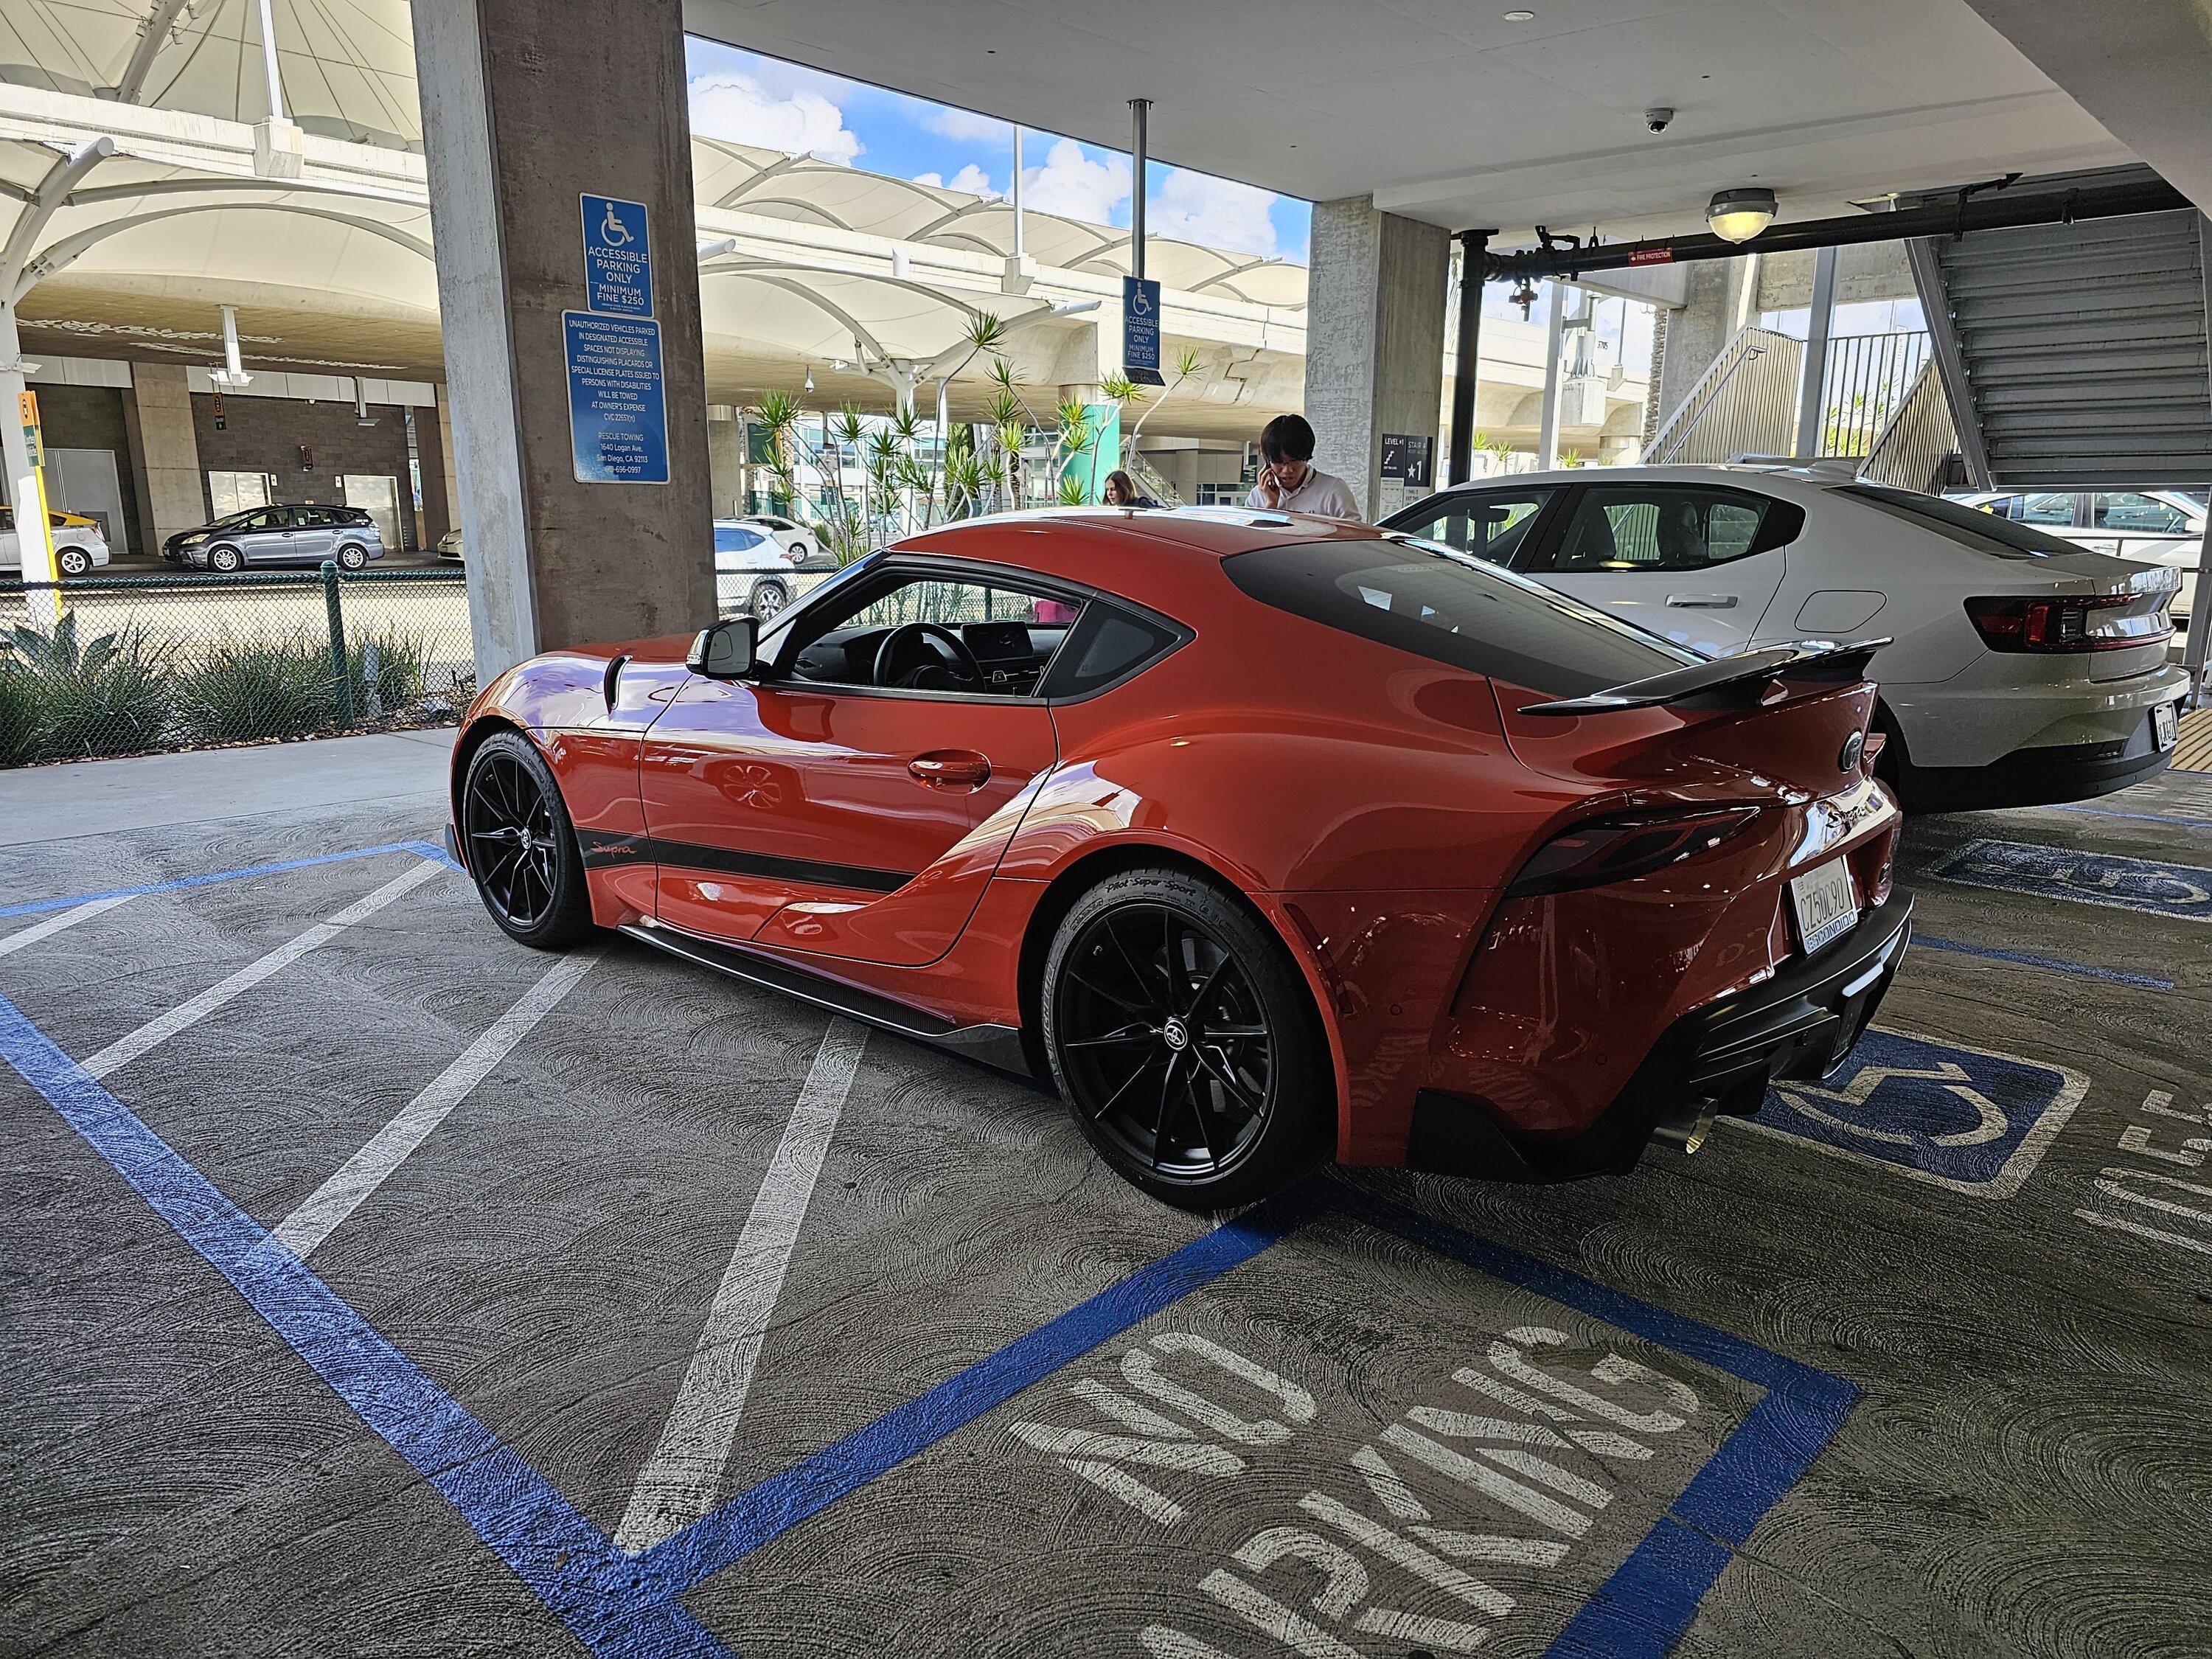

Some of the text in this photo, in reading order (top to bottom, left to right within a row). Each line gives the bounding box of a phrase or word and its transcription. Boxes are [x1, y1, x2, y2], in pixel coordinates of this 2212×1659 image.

[588, 246, 647, 263] ACCESSIBLE
[597, 259, 640, 274] PARKING
[606, 272, 632, 284] ONLY
[599, 284, 641, 296] MINIMUM
[597, 293, 619, 302] FINE
[622, 295, 644, 306] $250
[568, 319, 655, 335] UNAUTHORIZED VEHICLES PARKED
[1124, 316, 1158, 327] ACCESSIBLE
[1128, 324, 1154, 335] PARKING
[579, 332, 648, 347] IN DESIGNATED ACCESSIBLE
[1133, 335, 1150, 344] ONLY
[583, 344, 645, 357] SPACES NOT DISPLAYING
[1129, 344, 1154, 353] MINIMUM
[1127, 350, 1155, 360] FINE $250
[577, 355, 653, 369] DISTINGUISHING PLACARDS OR
[571, 365, 660, 380] SPECIAL LICENSE PLATES ISSUED TO
[582, 378, 652, 390] PERSONS WITH DISABILITIES
[598, 390, 638, 400] WILL BE TOWED
[591, 400, 646, 412] AT OWNER'S EXPENSE
[603, 413, 615, 421] CVC
[598, 432, 644, 442] RESCUE TOWING
[600, 443, 613, 451] 1640
[614, 444, 631, 453] Logan
[596, 453, 607, 462] San
[607, 454, 625, 463] Diego,
[591, 841, 637, 859] Supra
[1105, 879, 1129, 893] Pilot
[1132, 877, 1162, 887] Super
[1165, 880, 1197, 896] Sport
[1800, 877, 1845, 932] CZ50C90
[1806, 911, 1856, 950] ESCONDIDO
[1011, 1331, 1317, 1526] NO
[1138, 1326, 1700, 1659] RKING
